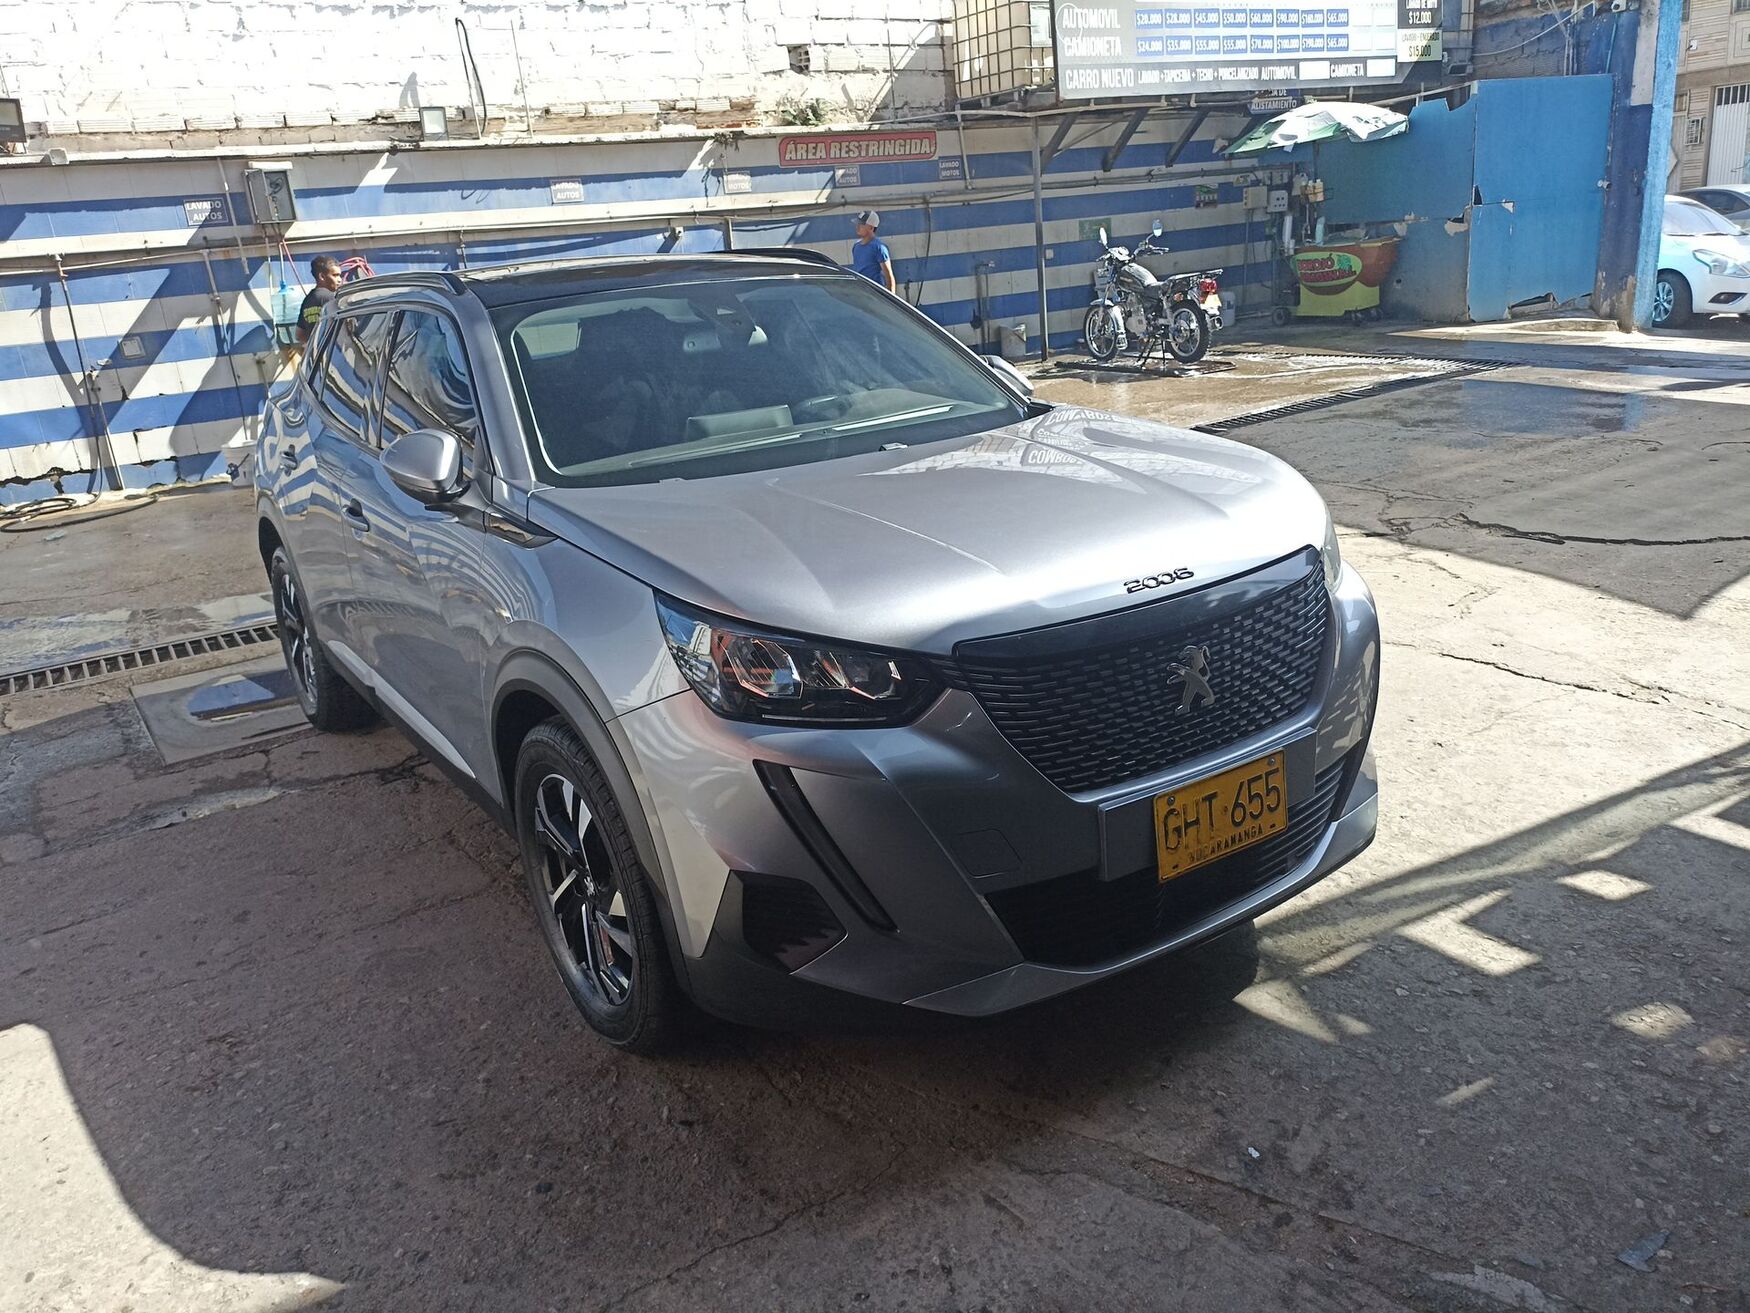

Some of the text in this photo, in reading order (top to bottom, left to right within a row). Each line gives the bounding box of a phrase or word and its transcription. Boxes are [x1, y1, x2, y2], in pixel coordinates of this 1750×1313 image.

[1195, 13, 1219, 24] $45.000
[1223, 13, 1246, 24] $50.000
[1327, 12, 1348, 23] $65.000
[1408, 11, 1431, 24] $12.000
[1064, 36, 1121, 56] CAMIONETA
[1137, 40, 1162, 52] $24.000
[1167, 39, 1191, 51] $35.000
[1195, 39, 1219, 51] $55.000
[1223, 39, 1247, 50] $55.000
[1327, 37, 1347, 48] $65.000
[1408, 45, 1431, 57] $15.000
[1065, 69, 1099, 89] CARRO
[1102, 68, 1134, 88] NUEVO
[1330, 63, 1365, 78] CAMIONETA
[1251, 100, 1297, 110] ALISTAMIENTO
[785, 138, 931, 160] ÁREA RESTRINGIDA
[556, 191, 580, 200] AUTOS
[186, 200, 221, 210] LAVADO
[193, 211, 223, 221] AUTOS
[1164, 767, 1281, 851] GHT 655
